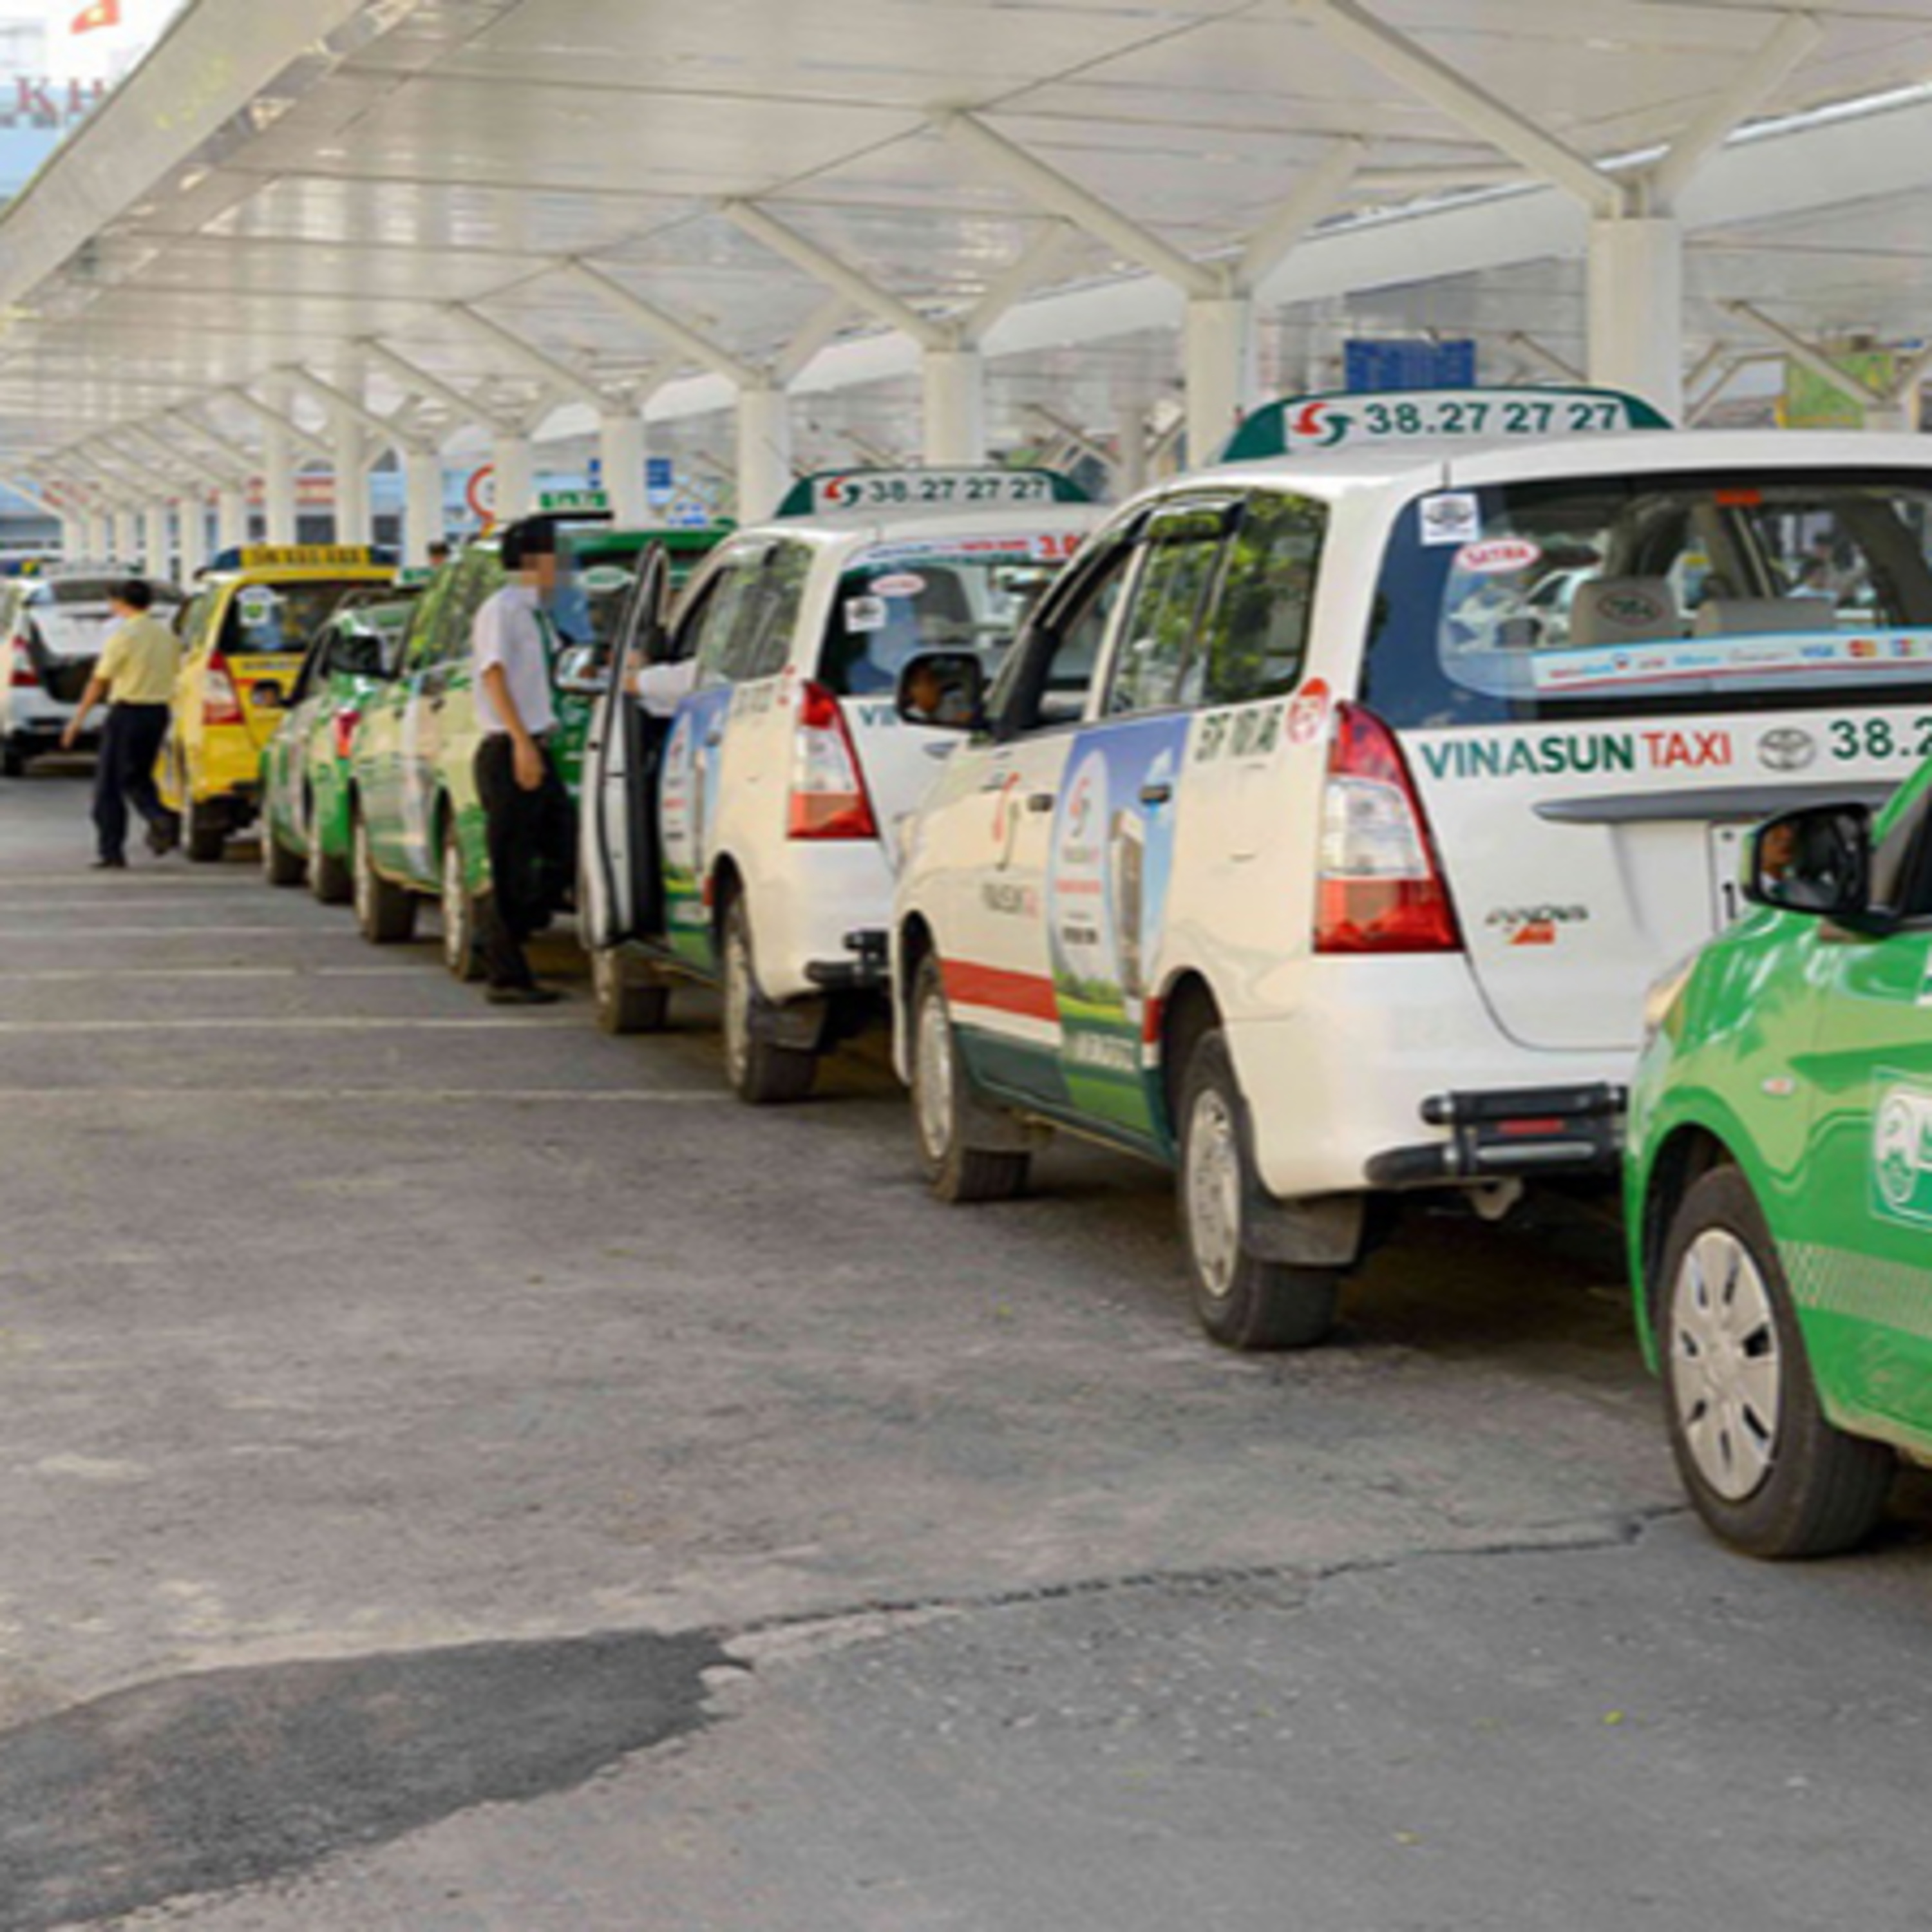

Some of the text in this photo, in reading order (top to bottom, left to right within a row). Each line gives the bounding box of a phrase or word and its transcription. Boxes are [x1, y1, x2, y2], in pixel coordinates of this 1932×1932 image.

[1364, 402, 1618, 435] 38.27 27 27
[870, 477, 1045, 502] 38.27 27 27
[1420, 731, 1731, 779] VINASUN TAXI
